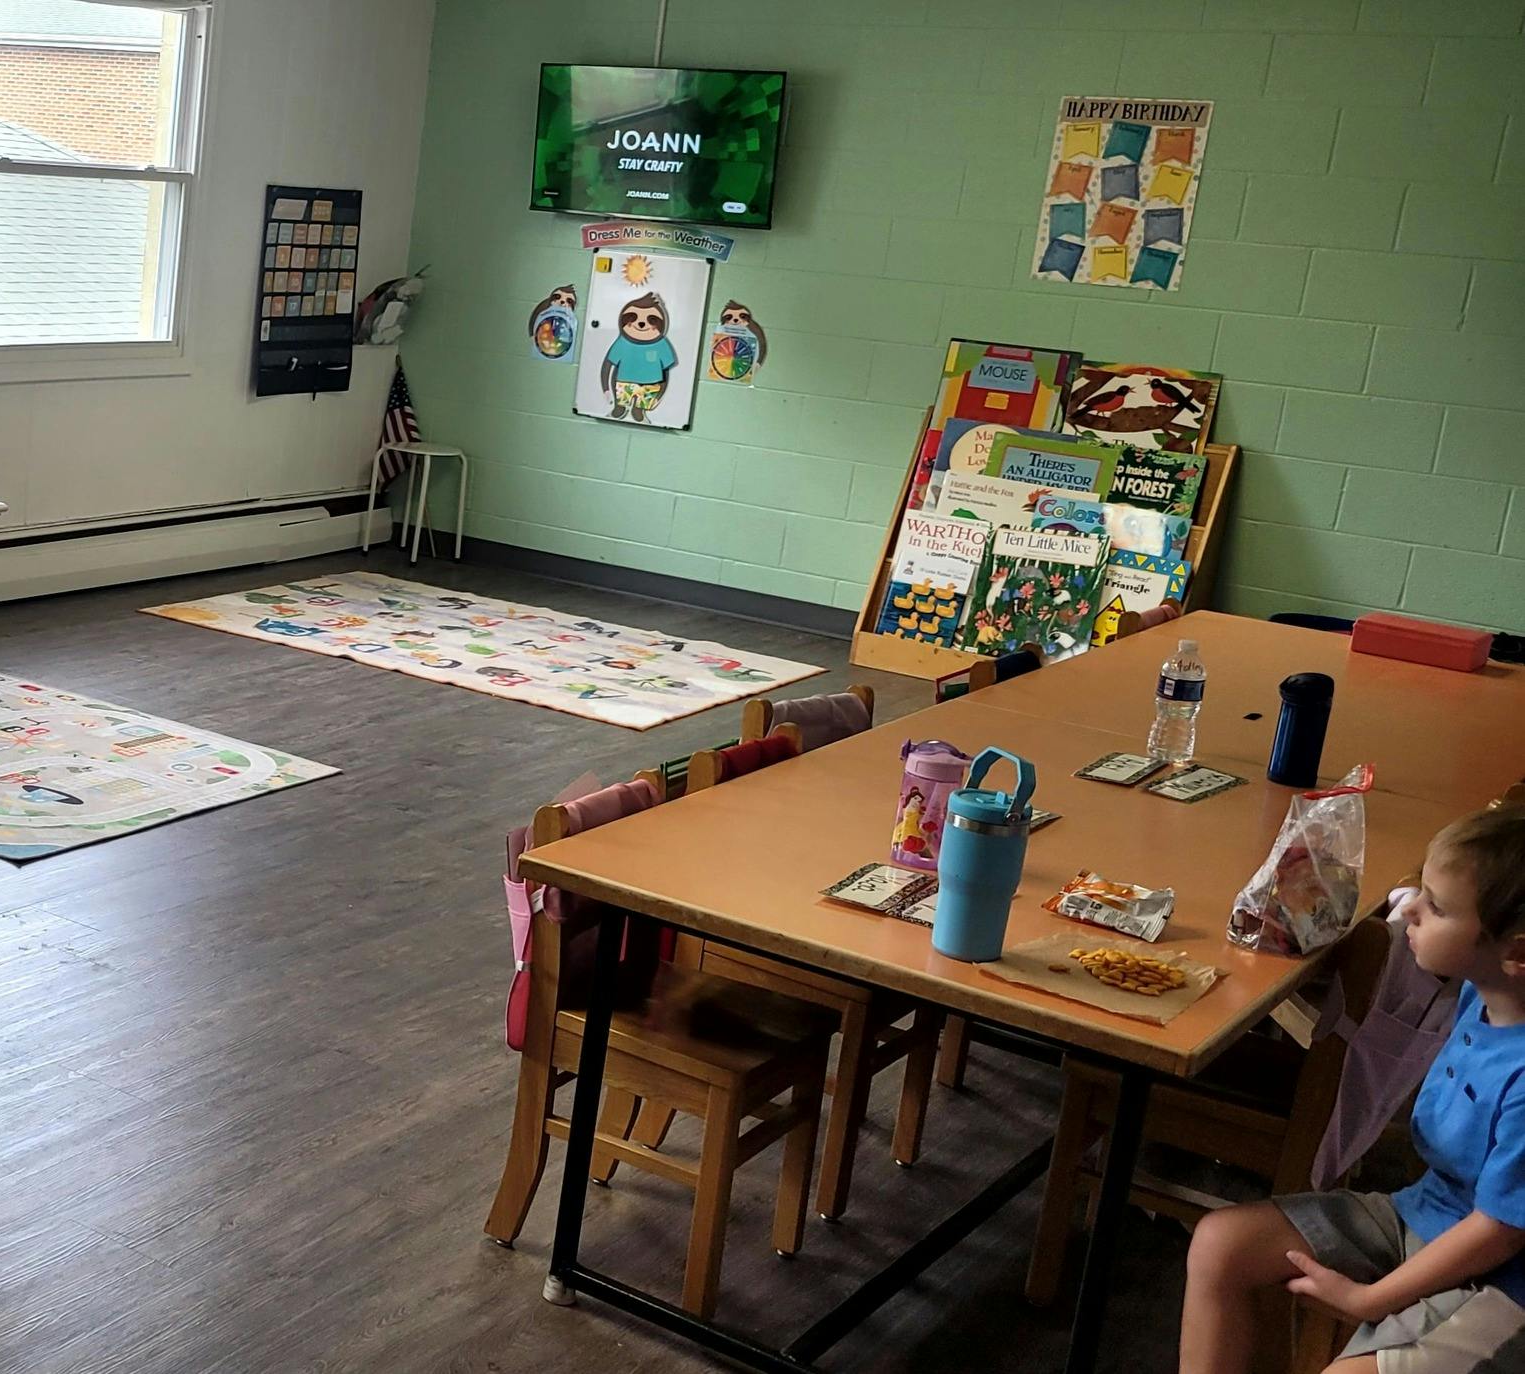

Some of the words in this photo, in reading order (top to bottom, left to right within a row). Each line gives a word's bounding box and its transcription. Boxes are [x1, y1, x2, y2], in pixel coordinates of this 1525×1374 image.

[1066, 102, 1119, 120] HAPPY
[1121, 103, 1206, 122] BIRTHDAY
[606, 130, 701, 154] JOANN
[618, 158, 644, 170] STAY
[644, 160, 684, 172] CRAFTY
[626, 190, 670, 200] JOANN.COM
[589, 229, 620, 242] Dress
[624, 228, 641, 238] Me
[644, 230, 655, 238] for
[658, 231, 671, 240] the
[674, 231, 725, 253] Weather
[979, 364, 1029, 381] MOUSE
[976, 431, 994, 440] Ma
[1006, 464, 1024, 476] AN
[1026, 468, 1092, 486] ALLIGATOR
[1154, 468, 1170, 479] the
[973, 484, 988, 492] and
[988, 486, 1000, 494] the
[1124, 478, 1176, 499] FOREST
[907, 518, 986, 545] WARTHO
[926, 539, 948, 551] the
[1004, 532, 1024, 546] Ten
[1028, 535, 1058, 550] Little
[1060, 539, 1092, 554] Mice
[1104, 578, 1151, 594] Triangle
